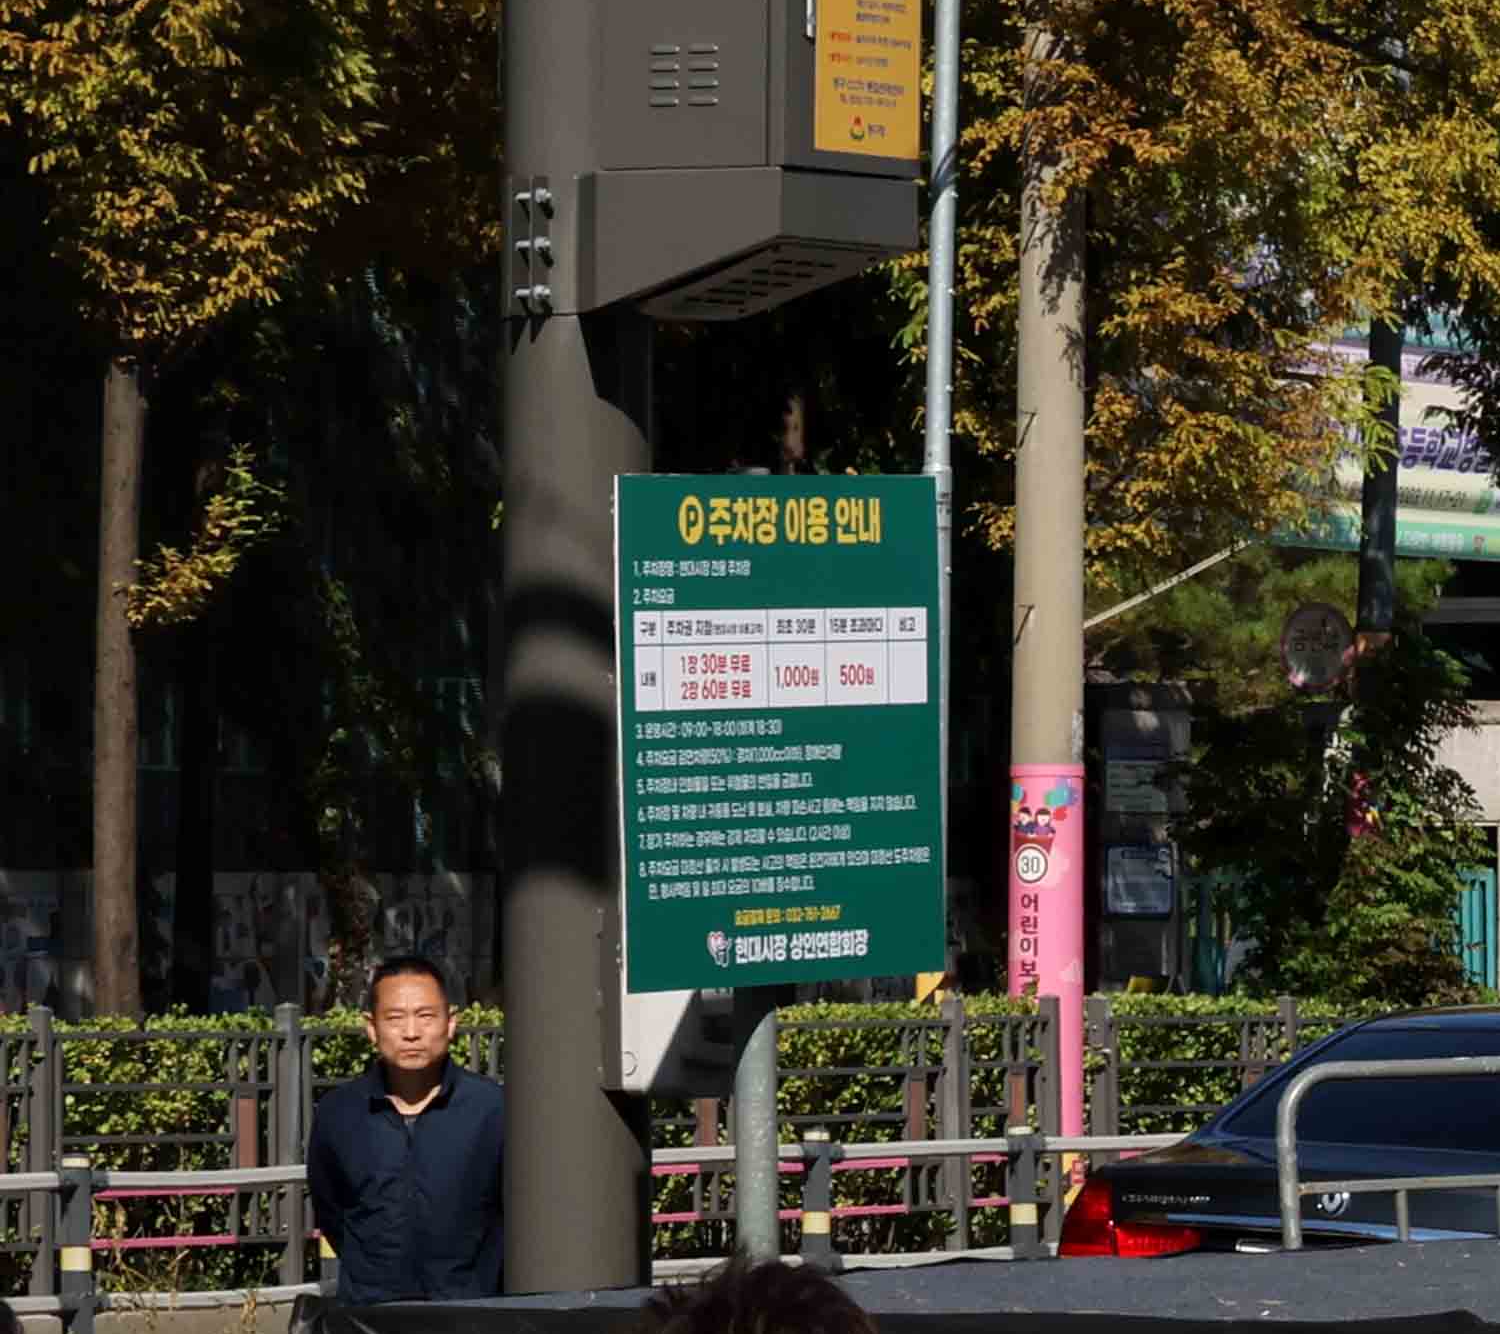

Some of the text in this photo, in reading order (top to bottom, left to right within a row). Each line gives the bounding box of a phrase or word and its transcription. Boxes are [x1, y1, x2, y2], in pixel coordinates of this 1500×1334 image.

[709, 497, 778, 545] 주차장
[785, 497, 830, 544] 이용
[835, 497, 881, 544] 안내
[681, 653, 752, 674] 1장 30분 무료
[775, 665, 819, 689] 1,000원
[840, 664, 875, 685] 500원
[681, 679, 752, 700] 2장 60분 무료
[1020, 855, 1041, 875] 30
[735, 934, 787, 964] 현대시장
